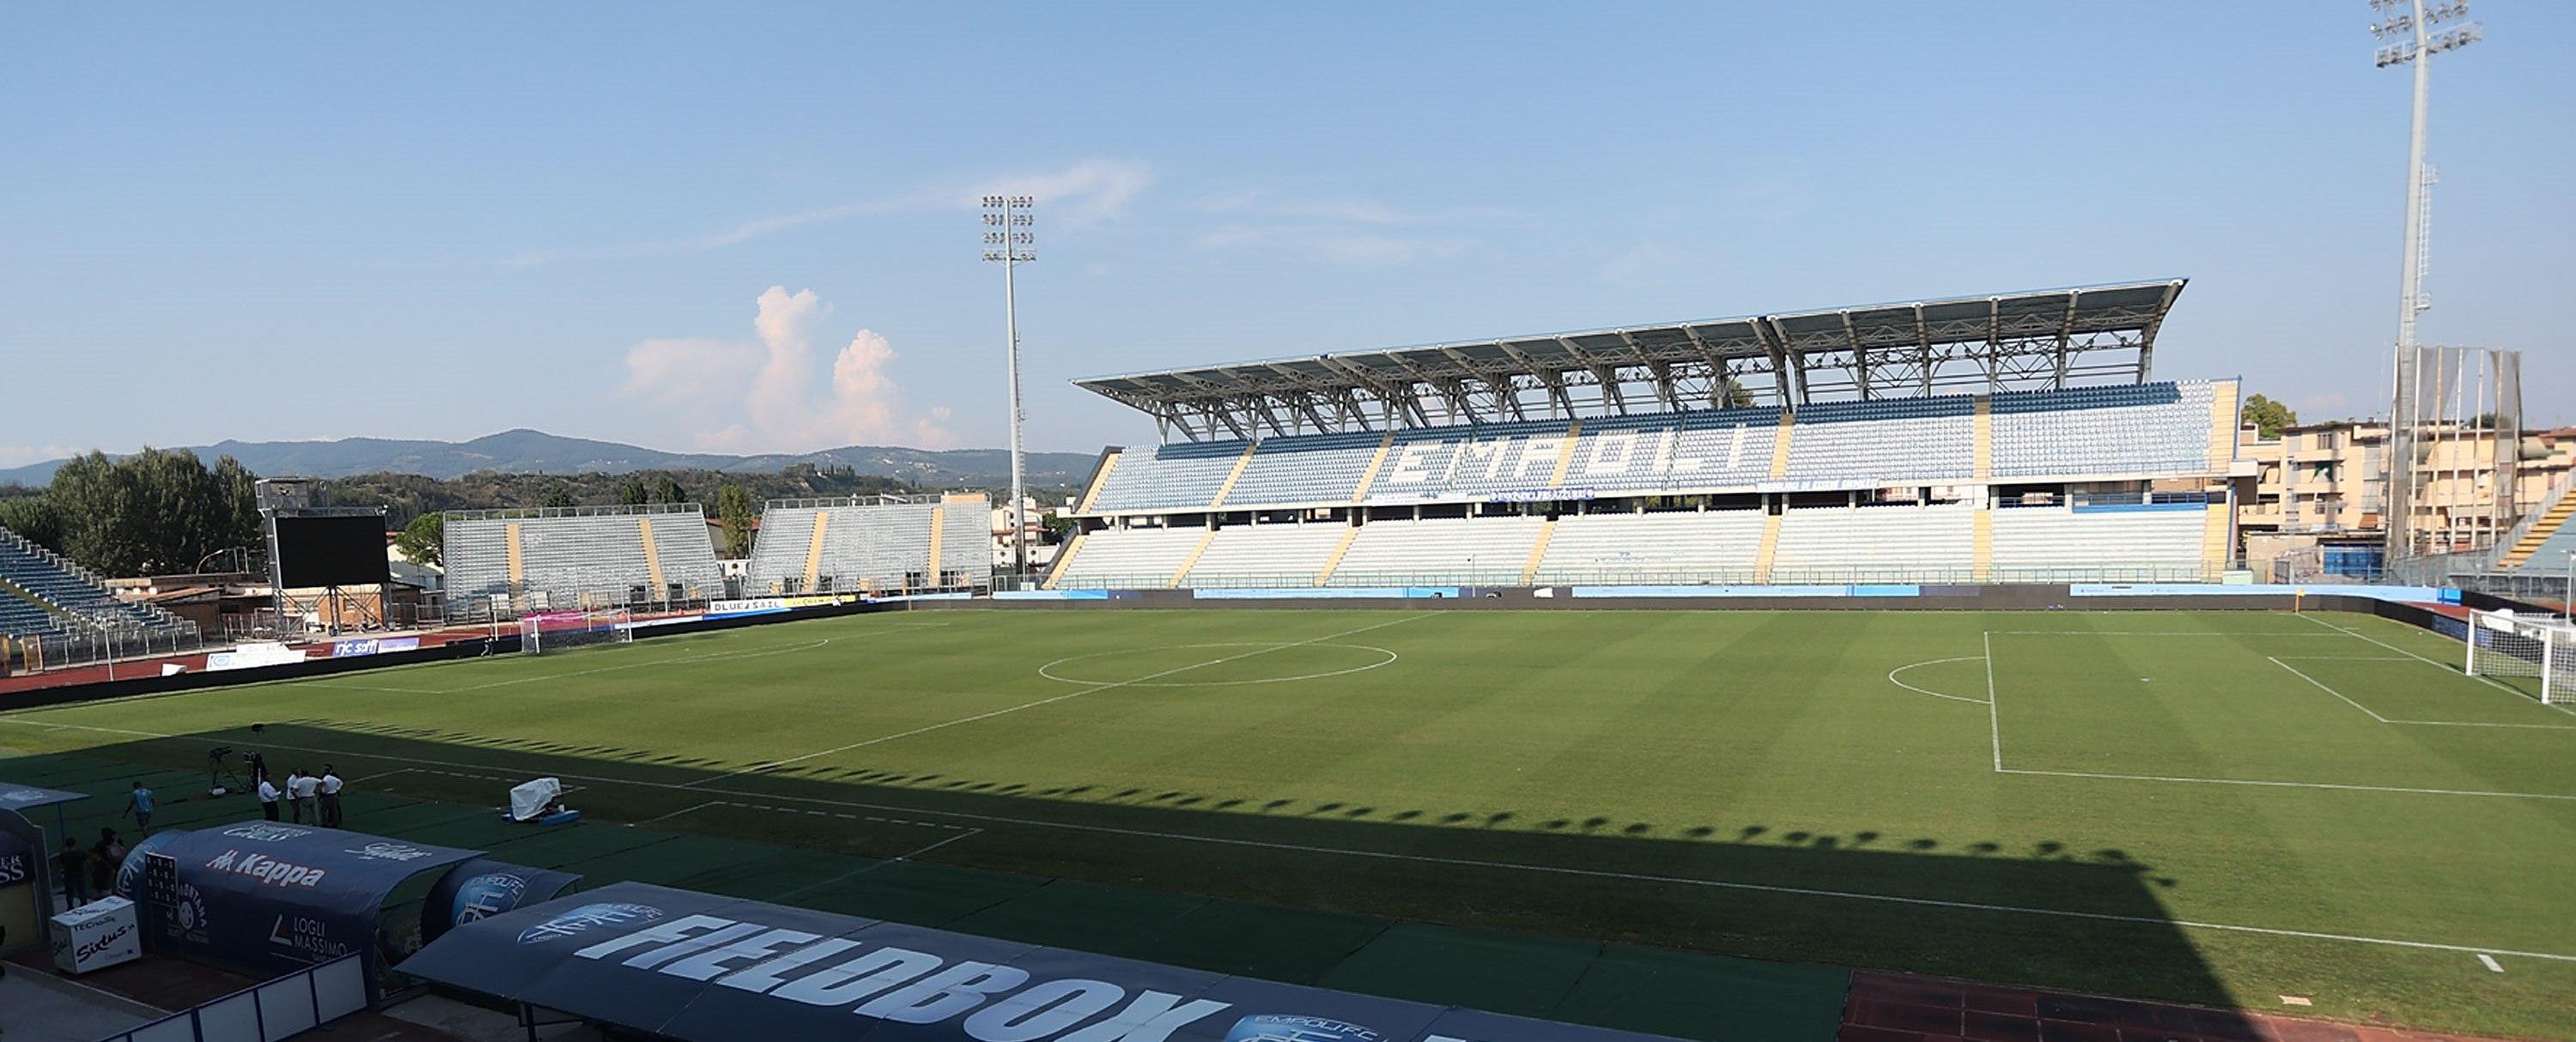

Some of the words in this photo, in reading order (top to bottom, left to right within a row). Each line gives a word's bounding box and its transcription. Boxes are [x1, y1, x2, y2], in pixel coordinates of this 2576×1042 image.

[1388, 423, 1747, 484] EMPOLI
[714, 602, 744, 611] BLUE
[235, 853, 326, 888] Kappa
[294, 917, 325, 937] LOGLI
[76, 926, 127, 964] Sixtus
[295, 935, 348, 956] MASSIMO
[573, 913, 1233, 1042] FIELDBOX
